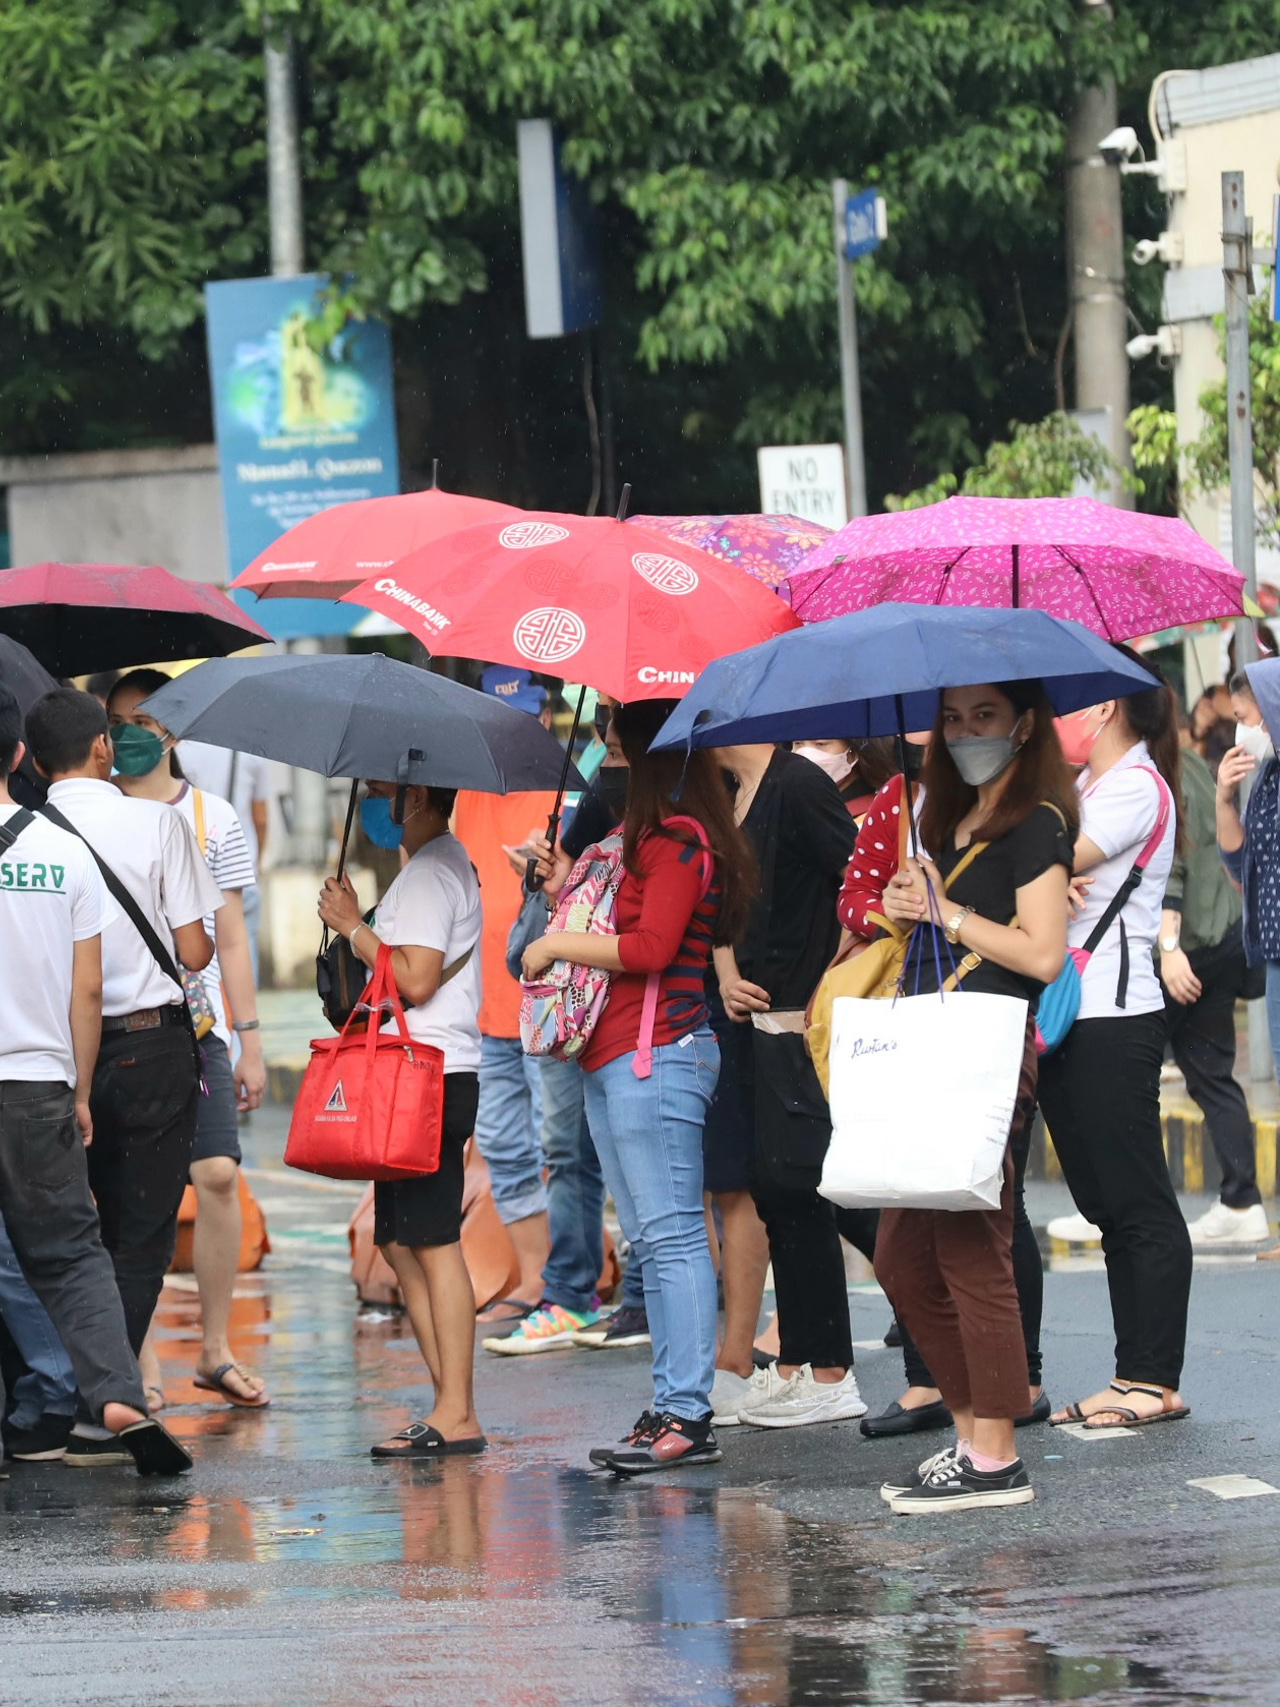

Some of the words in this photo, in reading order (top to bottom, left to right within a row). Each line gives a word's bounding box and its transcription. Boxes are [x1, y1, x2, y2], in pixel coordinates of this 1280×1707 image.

[787, 456, 818, 483] NO
[772, 488, 836, 514] ENTRY
[373, 578, 451, 631] CHINABANK
[637, 665, 701, 684] CHIN
